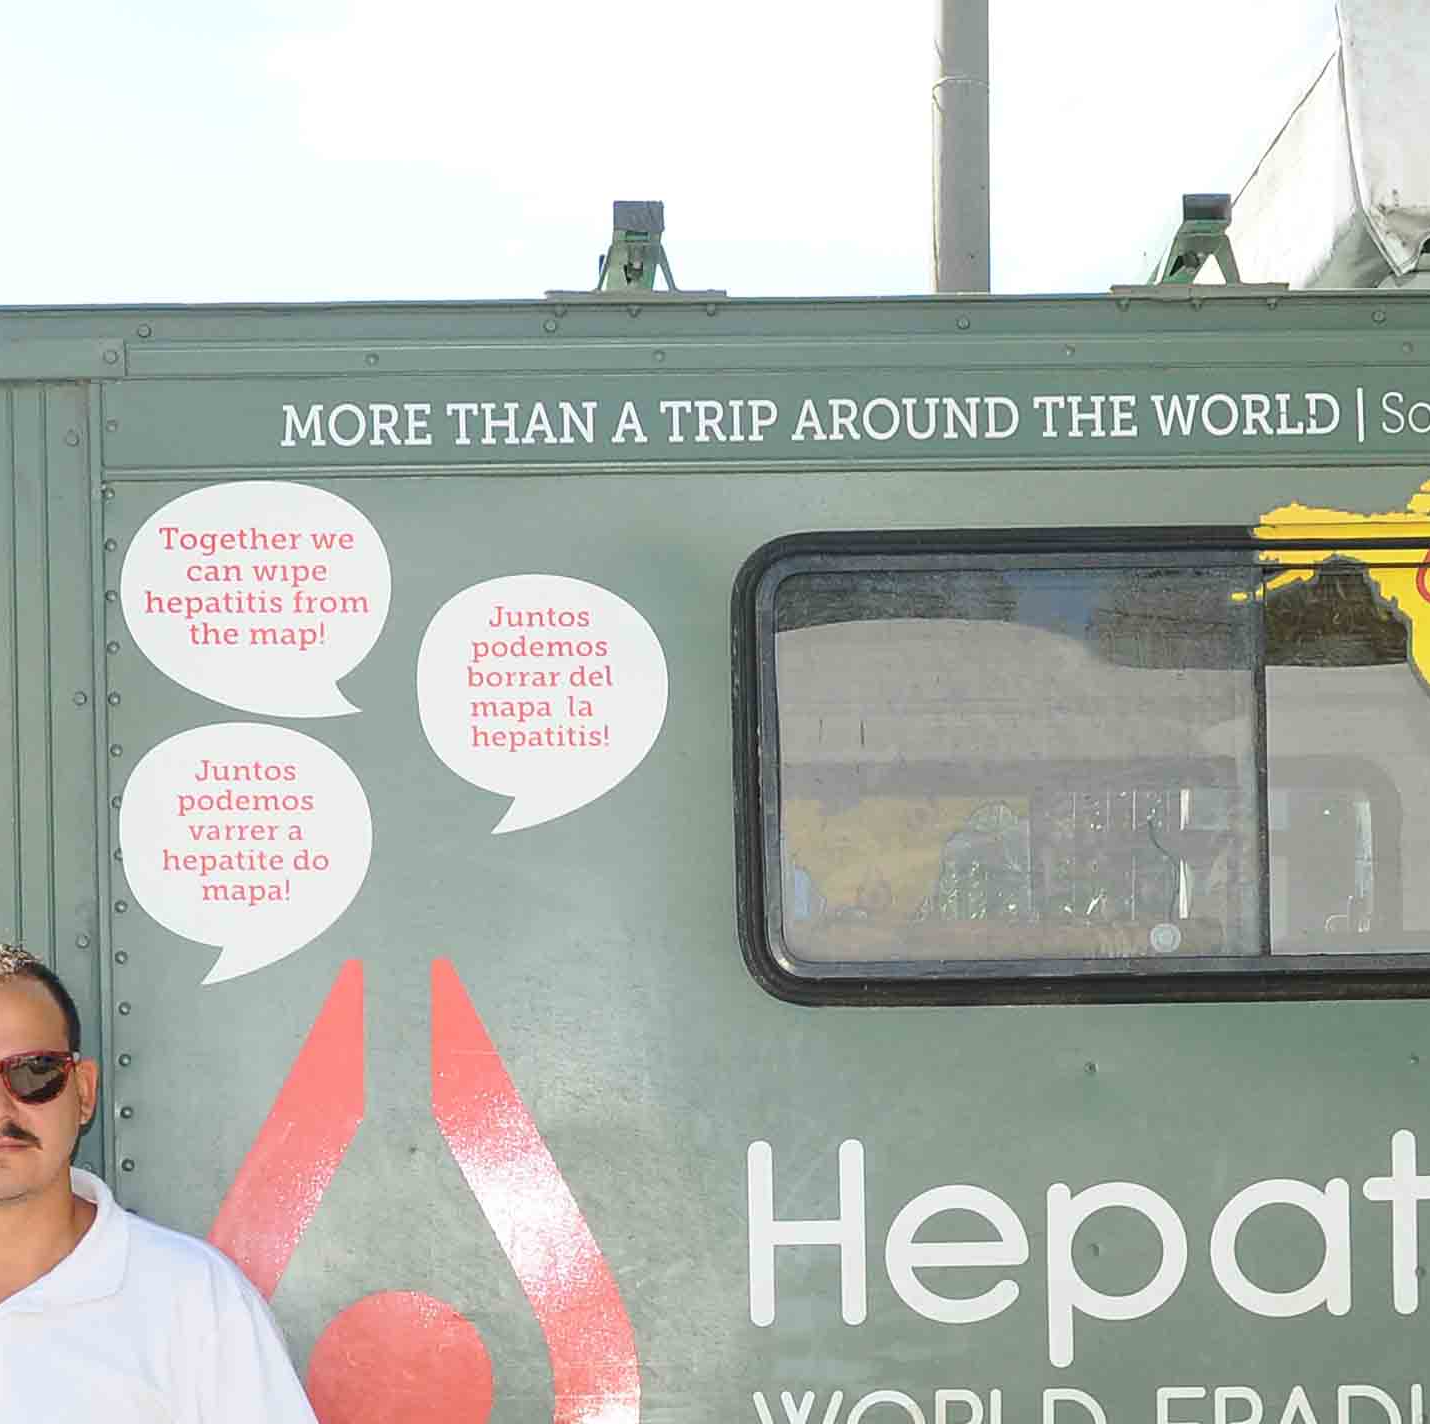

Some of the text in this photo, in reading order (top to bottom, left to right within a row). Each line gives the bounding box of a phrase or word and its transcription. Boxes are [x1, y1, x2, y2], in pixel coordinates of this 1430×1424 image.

[282, 405, 434, 447] MORE
[445, 404, 598, 446] THAN
[611, 402, 648, 443] A
[660, 400, 778, 443] TRIP
[792, 397, 1020, 441] AROUND
[1033, 396, 1139, 437] THE
[1150, 393, 1343, 437] WORLD
[158, 526, 354, 556] Together we
[186, 561, 328, 588] can wipe
[145, 592, 369, 616] hepatitis from
[488, 605, 591, 628] Juntos
[189, 624, 325, 652] the map!
[472, 636, 608, 662] podemos
[467, 666, 613, 688] borrar del
[470, 697, 594, 722] mapa la
[471, 726, 610, 753] hepatitis!
[194, 760, 296, 782] Juntos
[177, 791, 315, 816] podemos
[188, 823, 304, 841] varrer a
[162, 851, 330, 877] hepatite do
[202, 881, 291, 907] mapa!
